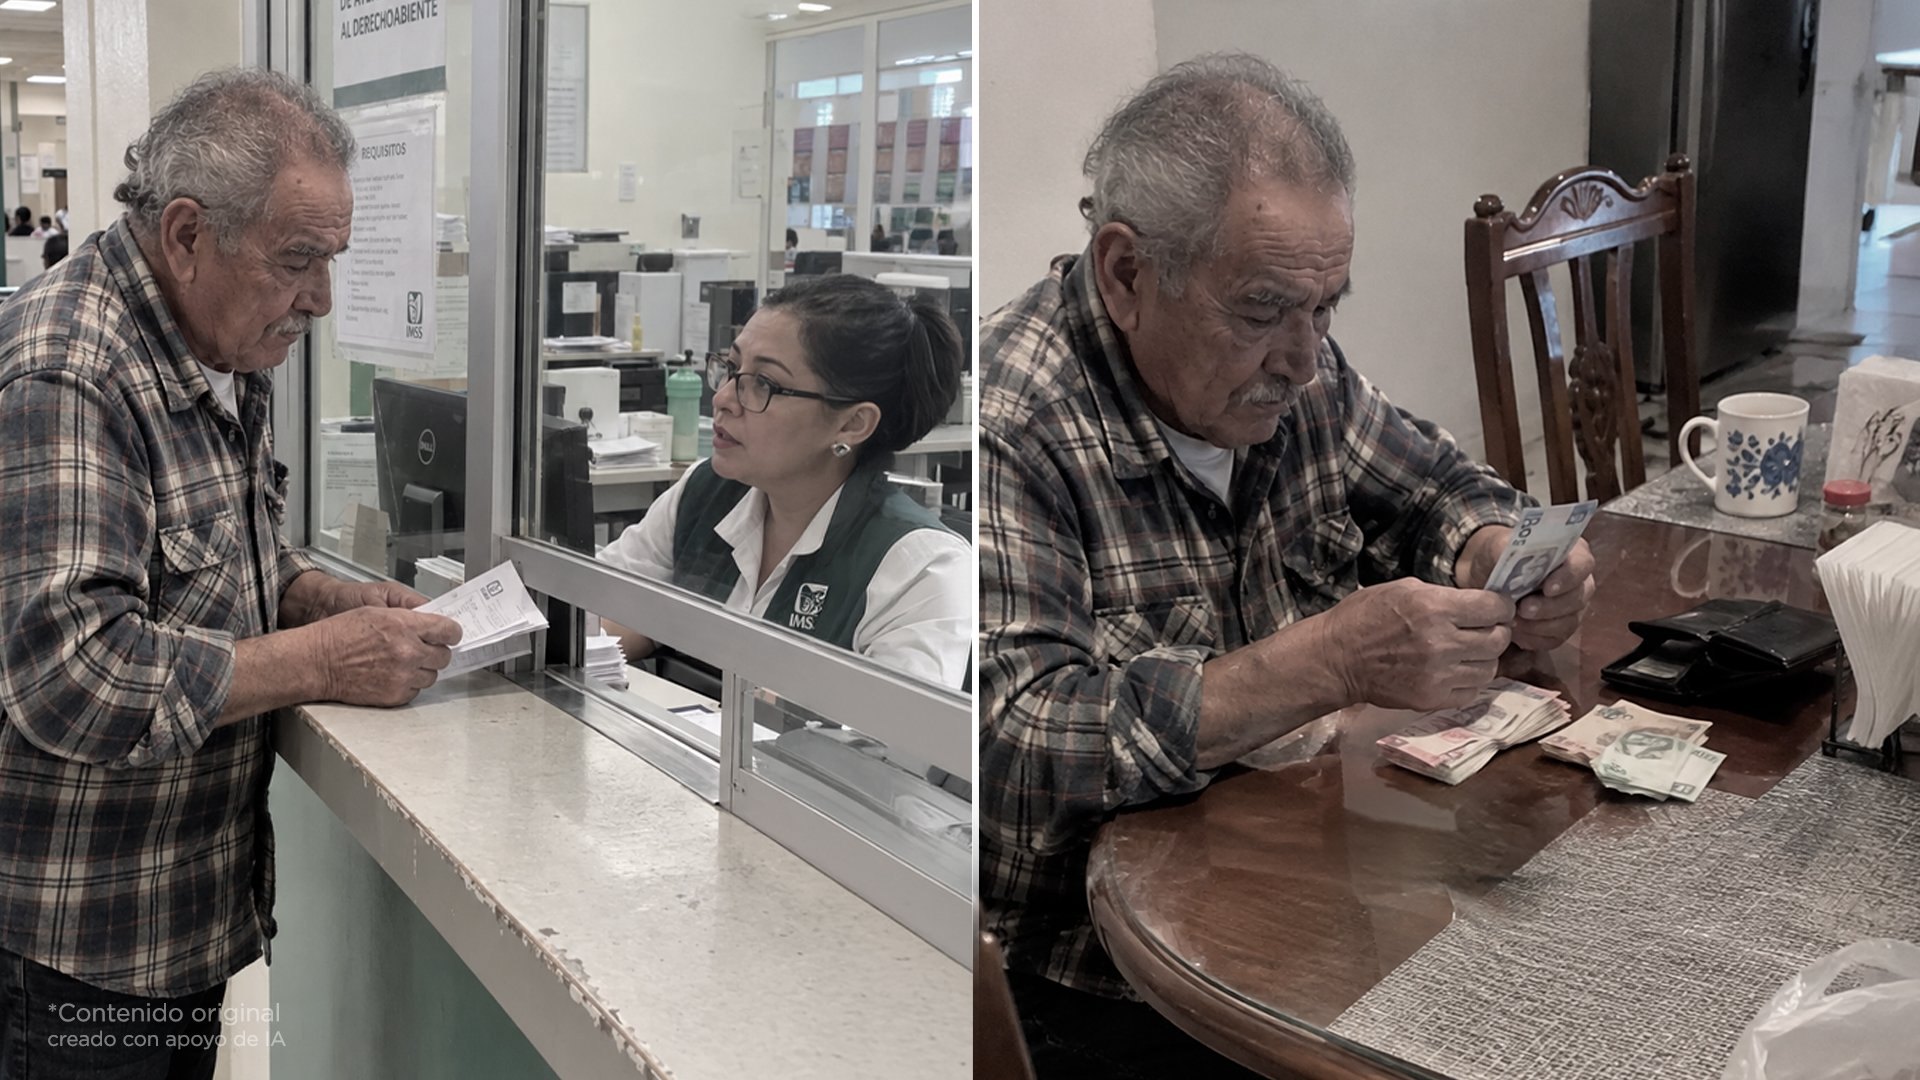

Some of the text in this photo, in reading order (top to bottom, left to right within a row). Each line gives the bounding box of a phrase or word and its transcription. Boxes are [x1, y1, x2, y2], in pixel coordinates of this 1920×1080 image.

[341, 0, 438, 40] AL DERECHOABIENTE
[361, 142, 407, 160] REQUISITOS
[406, 325, 423, 340] IMSS
